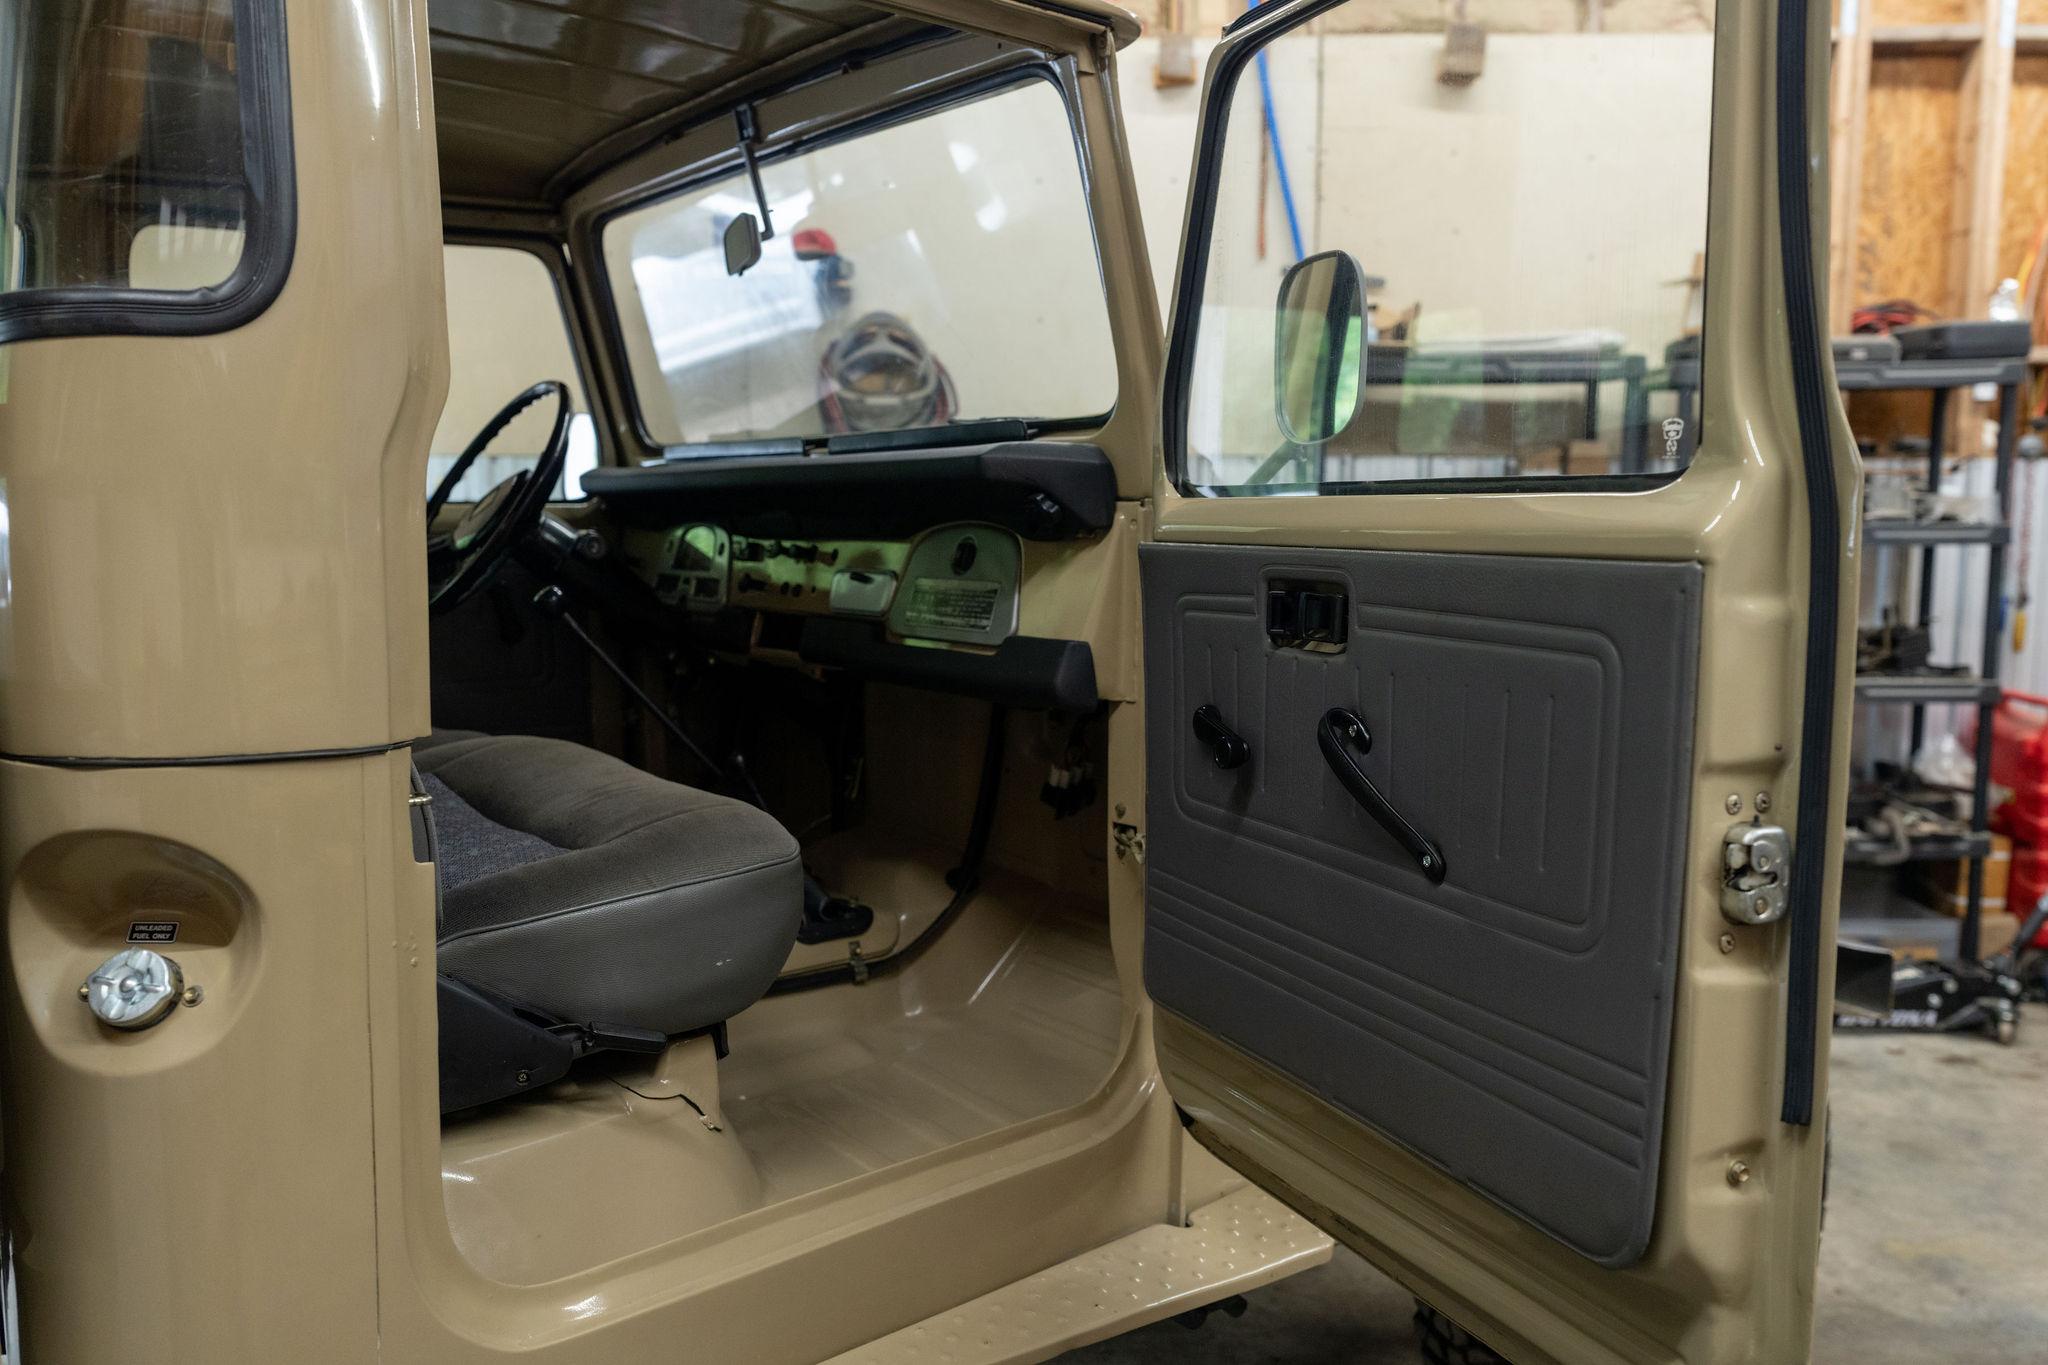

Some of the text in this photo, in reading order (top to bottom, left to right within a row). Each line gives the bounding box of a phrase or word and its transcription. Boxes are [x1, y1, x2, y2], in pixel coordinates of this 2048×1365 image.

[134, 924, 174, 932] UNLEADED
[132, 932, 171, 940] FUEL ONLY
